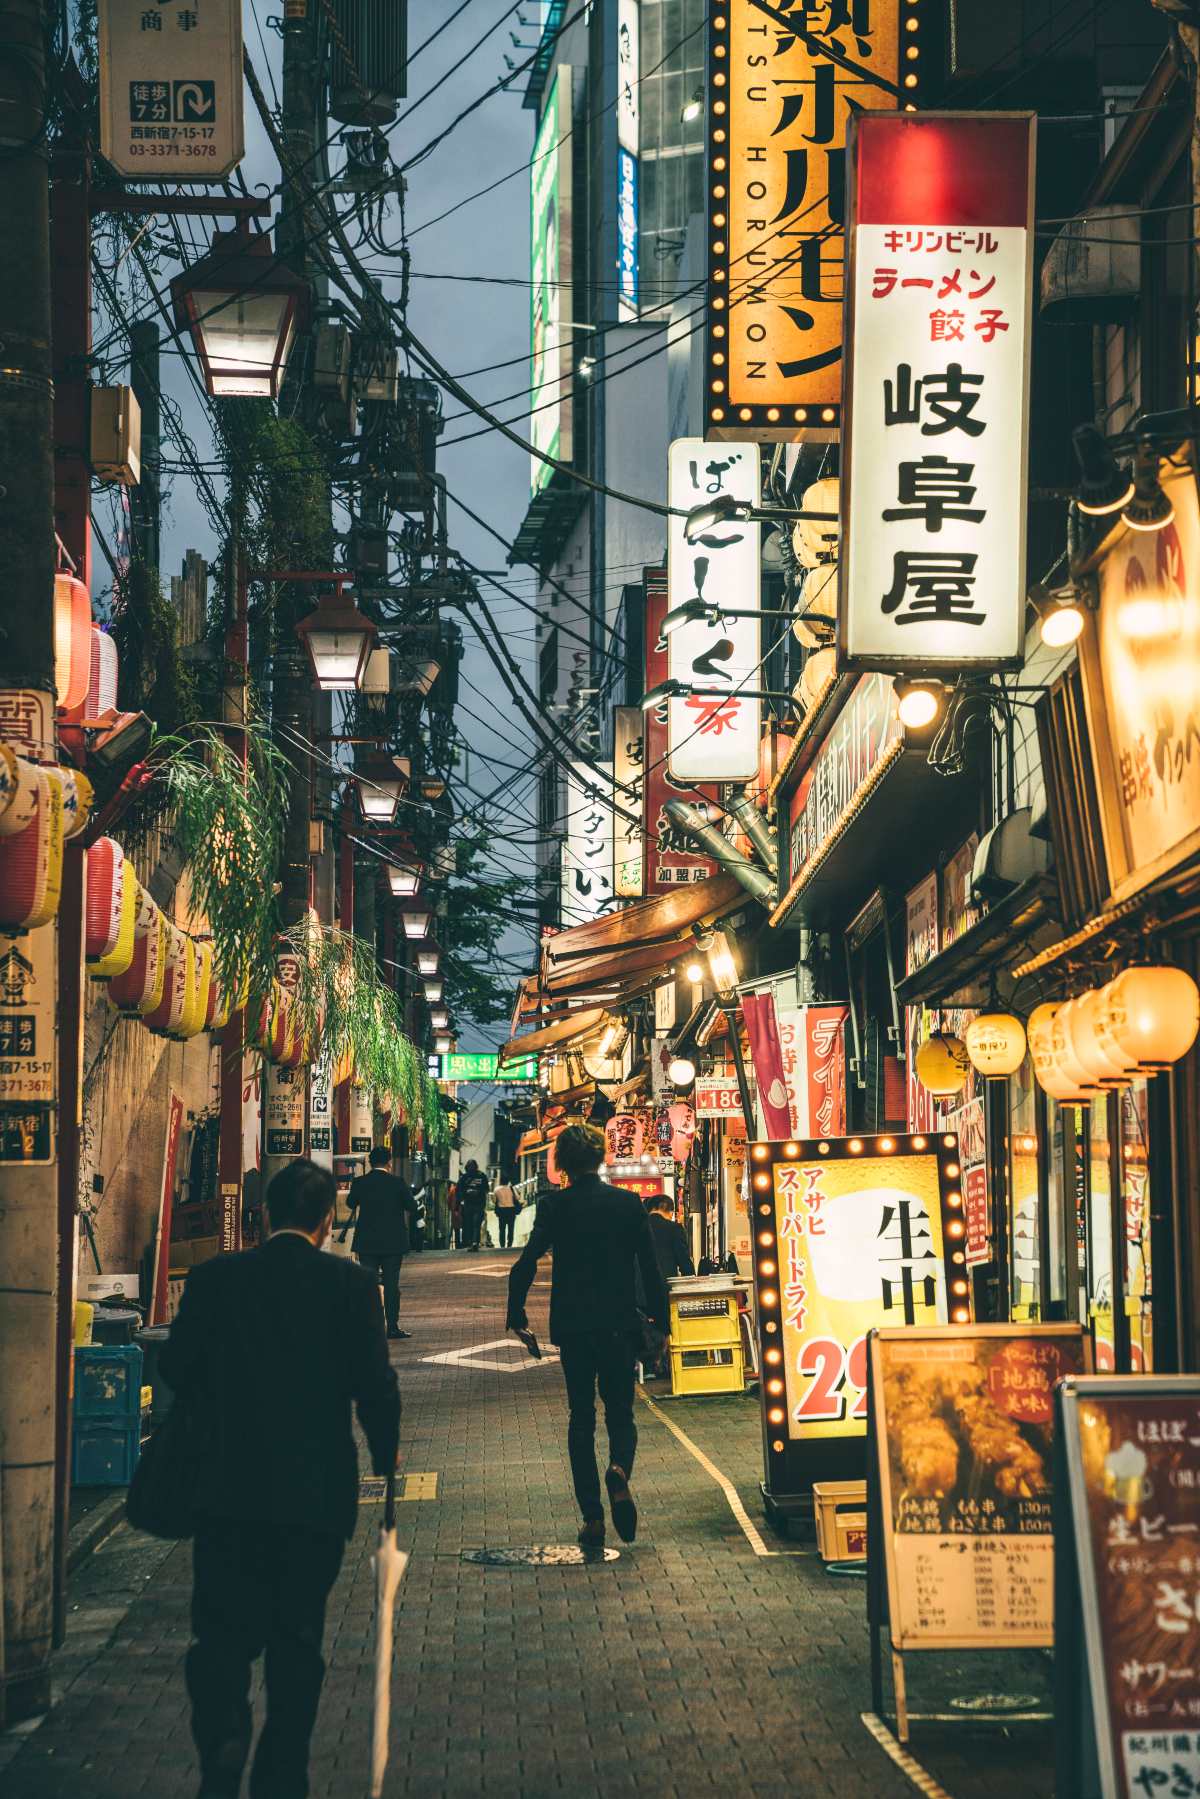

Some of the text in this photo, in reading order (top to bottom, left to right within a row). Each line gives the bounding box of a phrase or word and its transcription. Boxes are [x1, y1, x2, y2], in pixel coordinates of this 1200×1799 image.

[140, 10, 199, 31] 商事
[133, 84, 167, 101] 徒歩
[136, 104, 168, 119] 7分
[130, 126, 215, 140] 西新宿7-15-17
[129, 145, 217, 157] 03-3371-3678
[884, 230, 998, 255] キリンビール
[746, 147, 767, 379] HORUMON
[872, 267, 996, 299] ラーメン
[929, 308, 1010, 343] 餃子
[881, 363, 988, 626] 岐阜屋
[658, 867, 707, 883] 加盟店
[804, 1167, 826, 1236] アサヒ
[223, 1211, 232, 1251] GRAFFITI
[778, 1167, 808, 1332] スーパードライ
[876, 1200, 938, 1325] 生中
